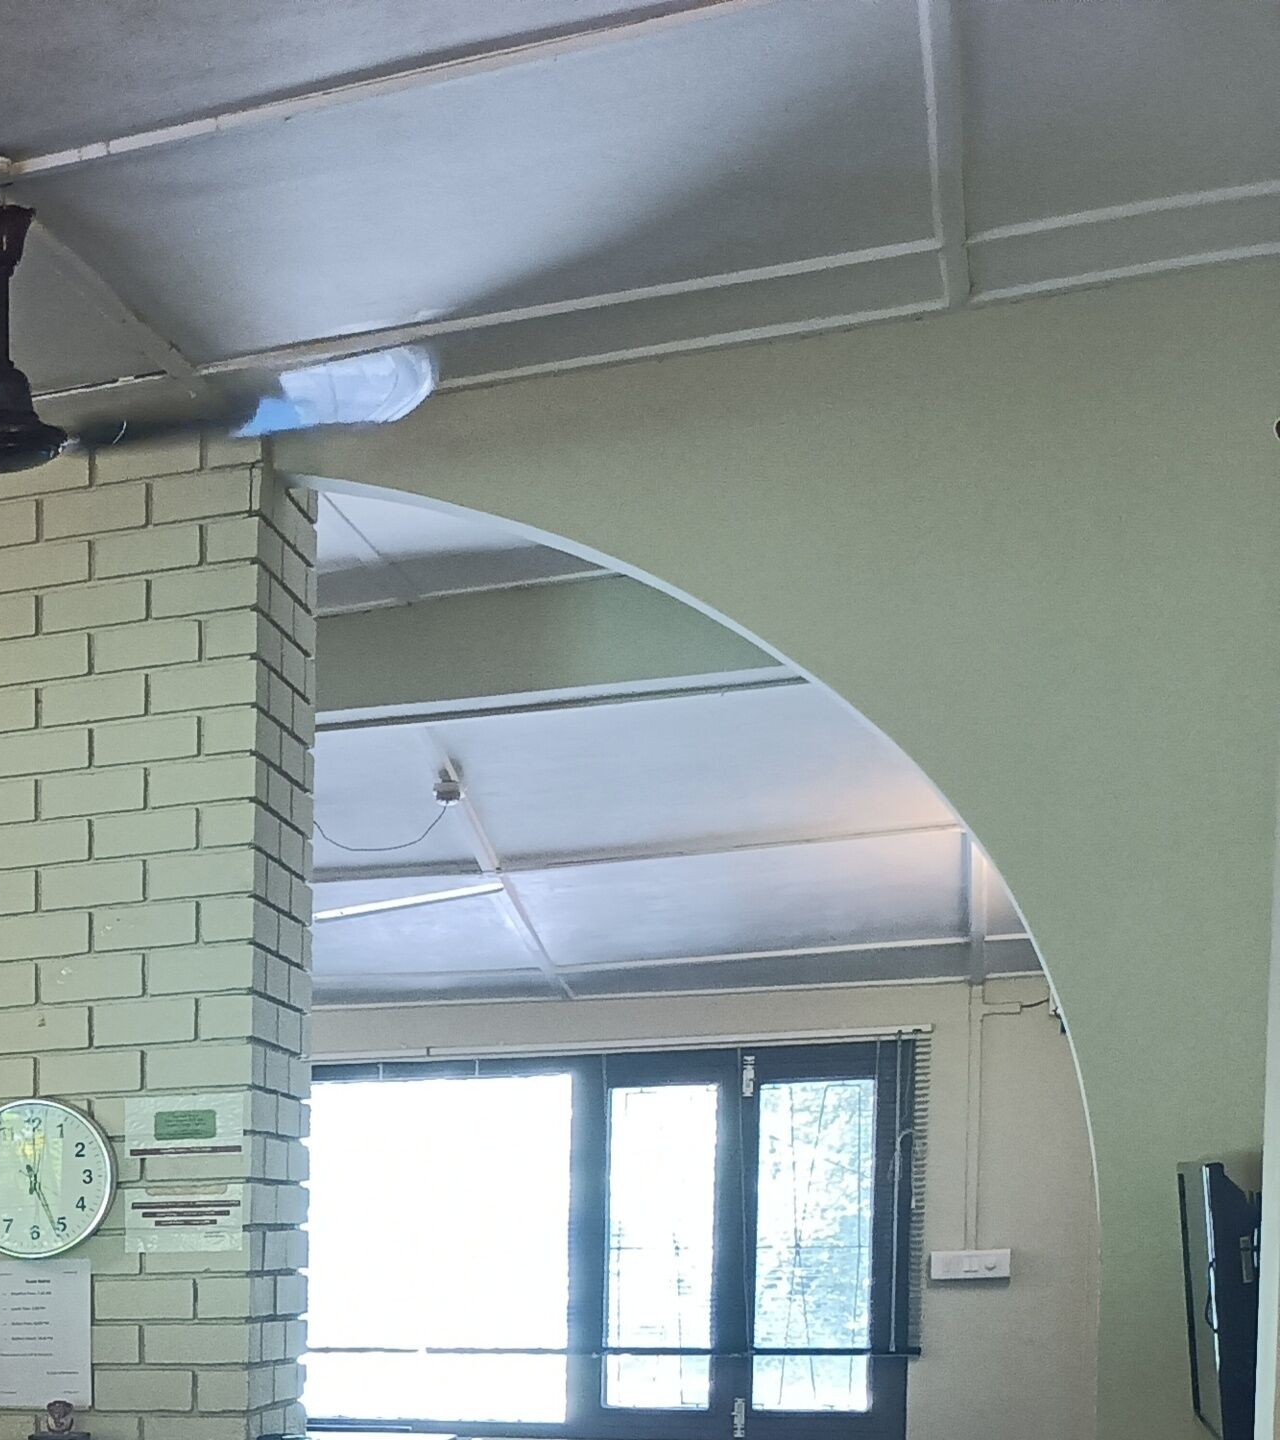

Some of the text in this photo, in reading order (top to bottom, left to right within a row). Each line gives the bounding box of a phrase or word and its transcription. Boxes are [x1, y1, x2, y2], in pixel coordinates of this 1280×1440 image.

[24, 1117, 42, 1132] 12
[56, 1123, 64, 1138] 1
[75, 1142, 86, 1157] 2
[82, 1169, 93, 1184] 3
[75, 1196, 86, 1211] 4
[2, 1219, 13, 1233] 7
[56, 1217, 67, 1232] 5
[30, 1225, 40, 1240] 6
